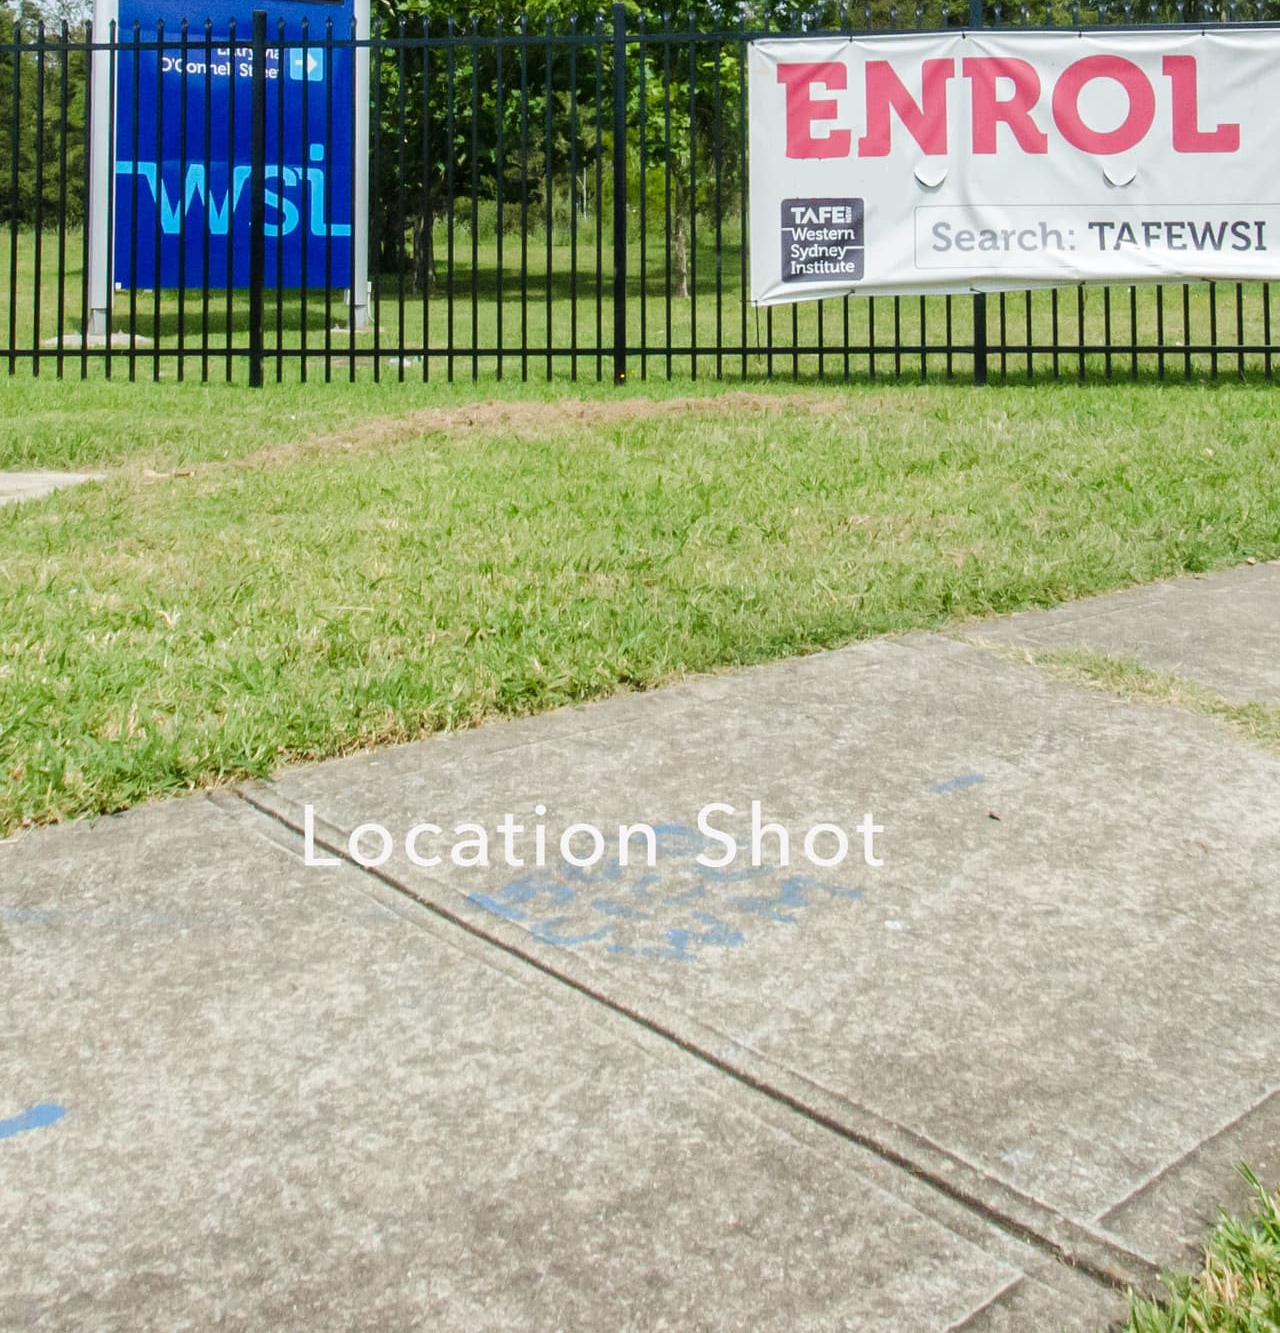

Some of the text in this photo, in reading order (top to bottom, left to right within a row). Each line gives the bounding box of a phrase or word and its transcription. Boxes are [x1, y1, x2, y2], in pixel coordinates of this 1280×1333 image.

[161, 57, 232, 77] O'Connel
[776, 53, 1240, 160] ENROL
[791, 207, 845, 224] TAFE
[792, 227, 856, 241] Western
[931, 220, 1268, 253] Search: TAFEWSI
[791, 244, 847, 261] Sydney
[791, 260, 855, 275] Institute
